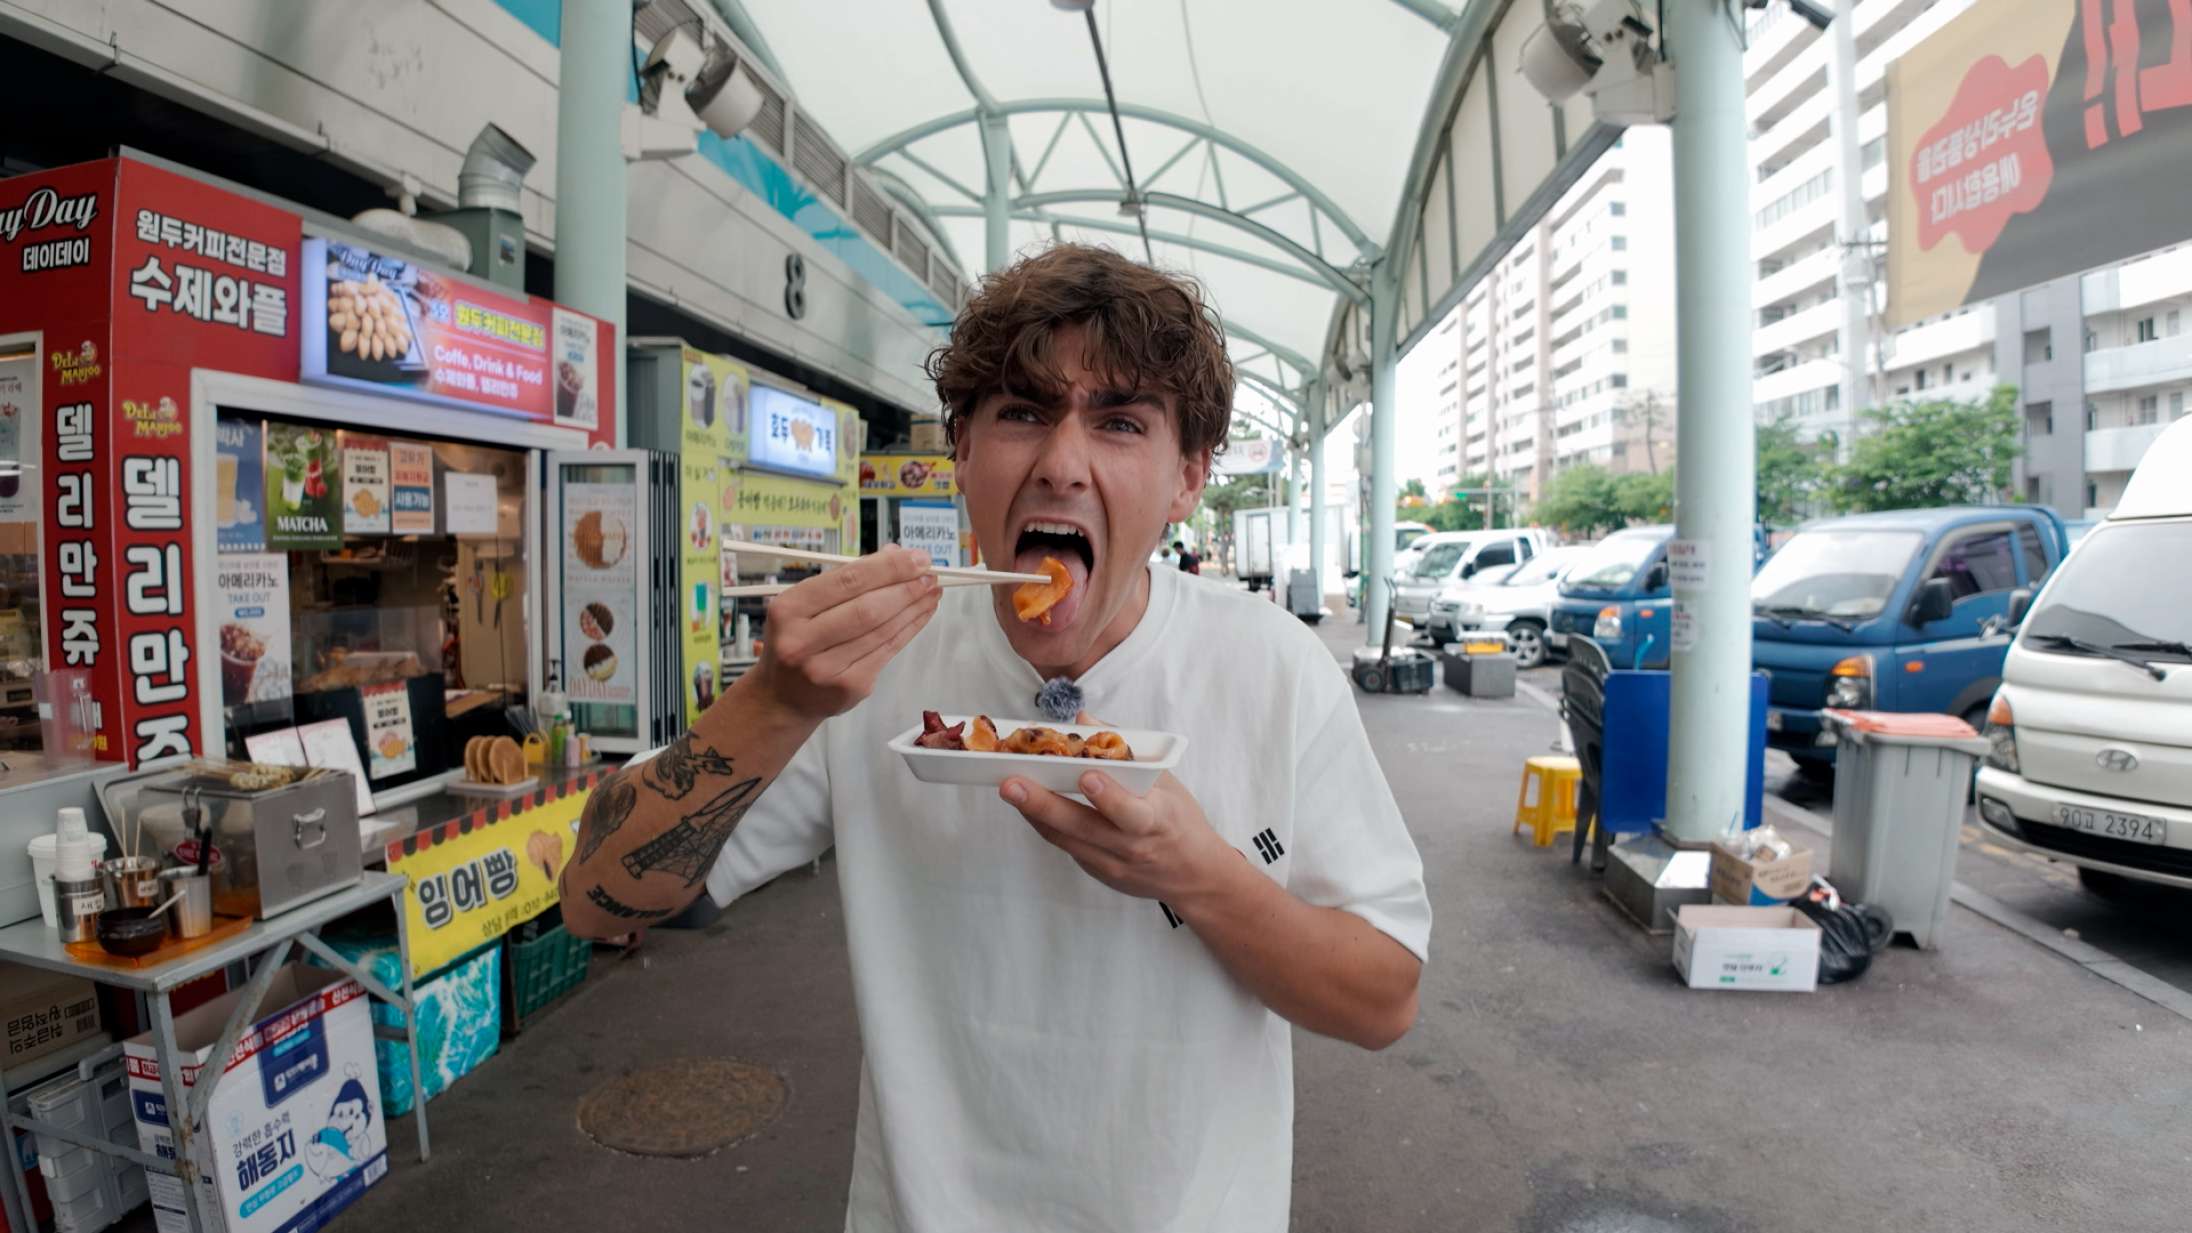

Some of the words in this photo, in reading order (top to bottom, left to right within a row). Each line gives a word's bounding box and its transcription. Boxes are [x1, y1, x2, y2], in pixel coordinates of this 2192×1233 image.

[24, 188, 97, 230] Day
[23, 238, 90, 272] 데이데이
[137, 210, 286, 277] 원두커피전문점
[131, 257, 287, 337] 수제와플
[784, 254, 805, 320] 8
[516, 364, 543, 385] Food
[56, 402, 99, 665] 델리만쥬
[277, 516, 328, 532] MATCHA
[904, 526, 955, 541] 아메리카노
[218, 572, 278, 589] 아메리카노
[228, 592, 251, 604] TAKE
[253, 592, 271, 603] OUT
[2104, 814, 2153, 840] 2394
[418, 849, 518, 925] 잉어빵
[10, 1024, 63, 1055] 취급주의
[232, 1129, 262, 1158] 강력한
[236, 1128, 296, 1191] 해동지
